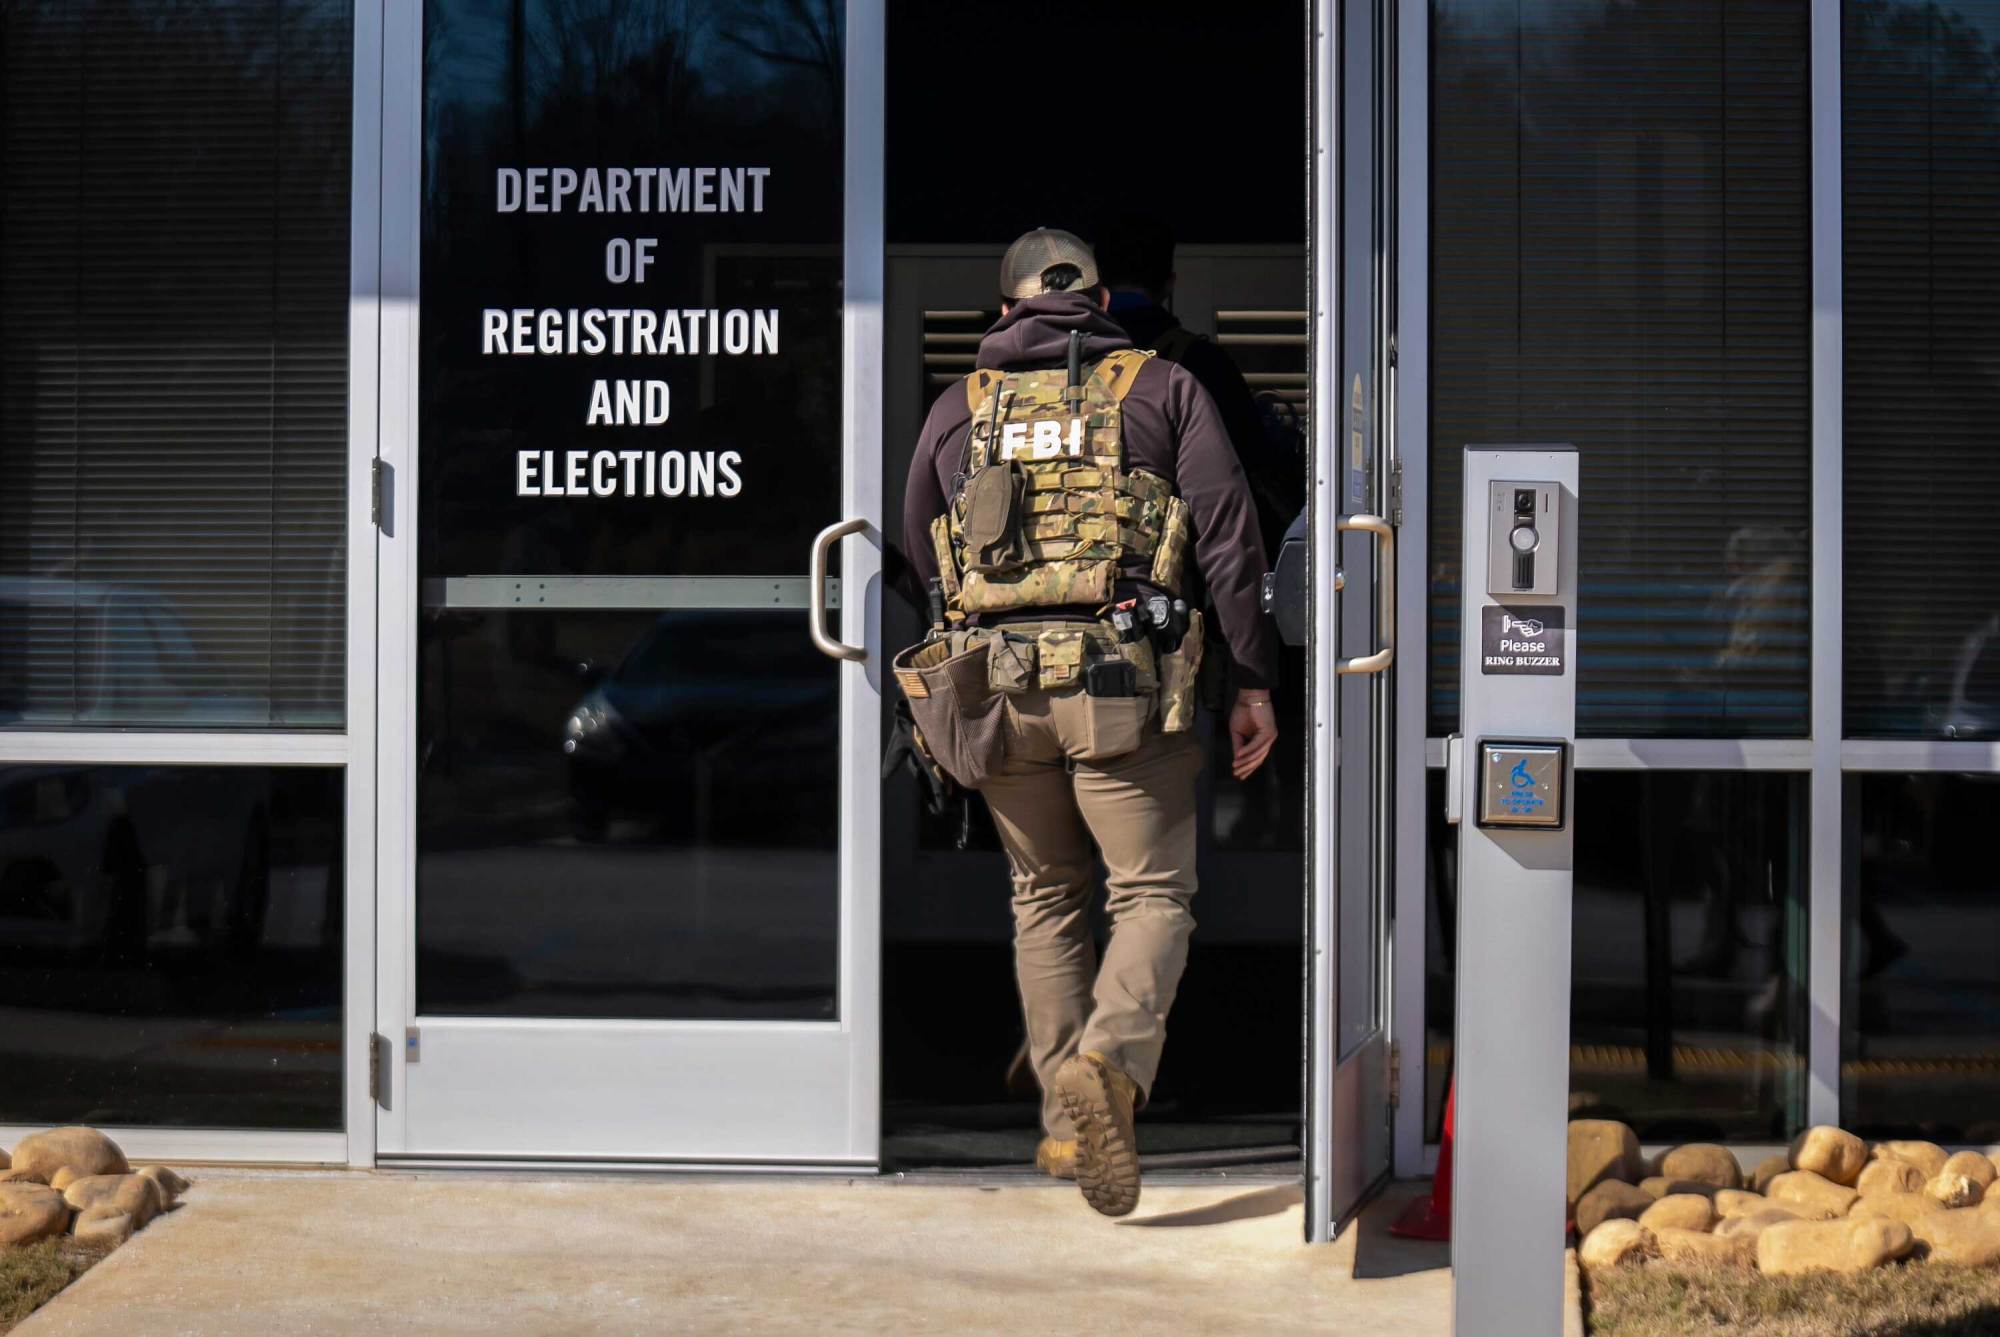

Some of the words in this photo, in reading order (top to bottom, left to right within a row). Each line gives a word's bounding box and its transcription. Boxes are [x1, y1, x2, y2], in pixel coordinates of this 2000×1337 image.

[496, 167, 771, 213] DEPARTMENT
[605, 238, 658, 284] OF
[482, 308, 779, 356] REGISTRATION
[585, 380, 670, 426] AND
[1001, 418, 1082, 460] FBI
[516, 450, 743, 498] ELECTIONS
[1485, 656, 1514, 666] RING
[1515, 656, 1560, 666] BUZZER
[1501, 639, 1545, 652] Please
